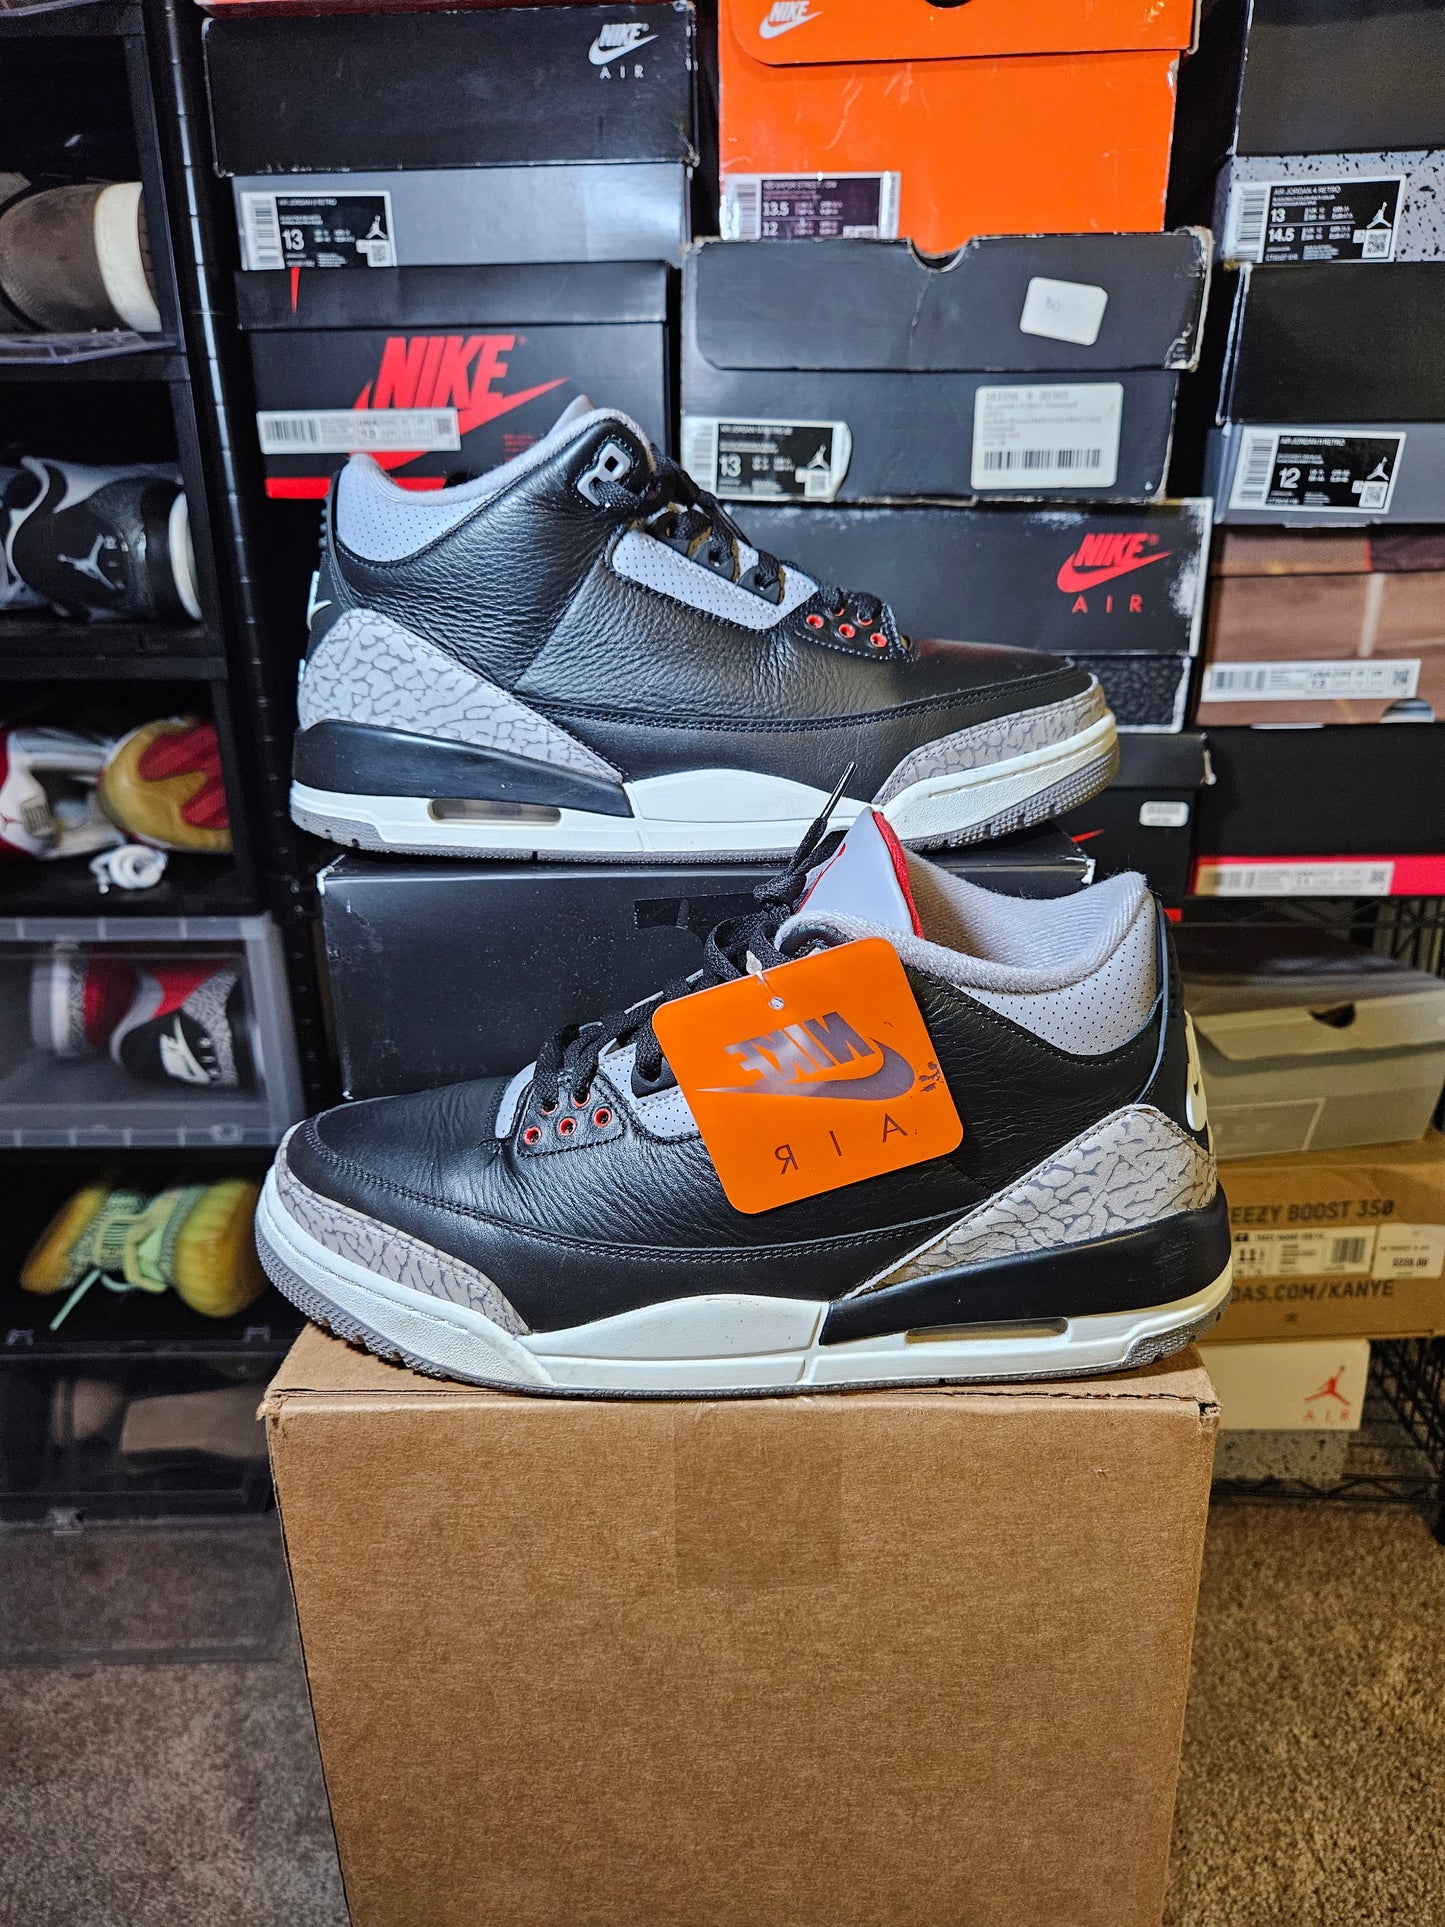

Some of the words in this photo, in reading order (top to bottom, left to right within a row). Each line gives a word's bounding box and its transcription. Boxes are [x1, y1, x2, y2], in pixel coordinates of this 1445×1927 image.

[768, 0, 811, 22] NIKE
[599, 23, 643, 48] NIKE
[600, 64, 644, 80] AIR
[763, 201, 790, 216] 13.5
[1271, 207, 1286, 223] 13
[282, 228, 305, 251] 13
[763, 221, 779, 236] 12
[1268, 227, 1296, 243] 14.5
[371, 335, 517, 409] NIKE
[719, 453, 742, 478] 13
[1279, 467, 1302, 489] 12
[1073, 533, 1148, 568] NIKE
[1071, 593, 1143, 614] AIR
[1231, 1205, 1283, 1224] EEZY
[1287, 1201, 1351, 1222] BOOST
[1357, 1199, 1396, 1218] 350
[1232, 1279, 1395, 1301] DAS.COM/KANYE
[1302, 1408, 1351, 1422] AIR
